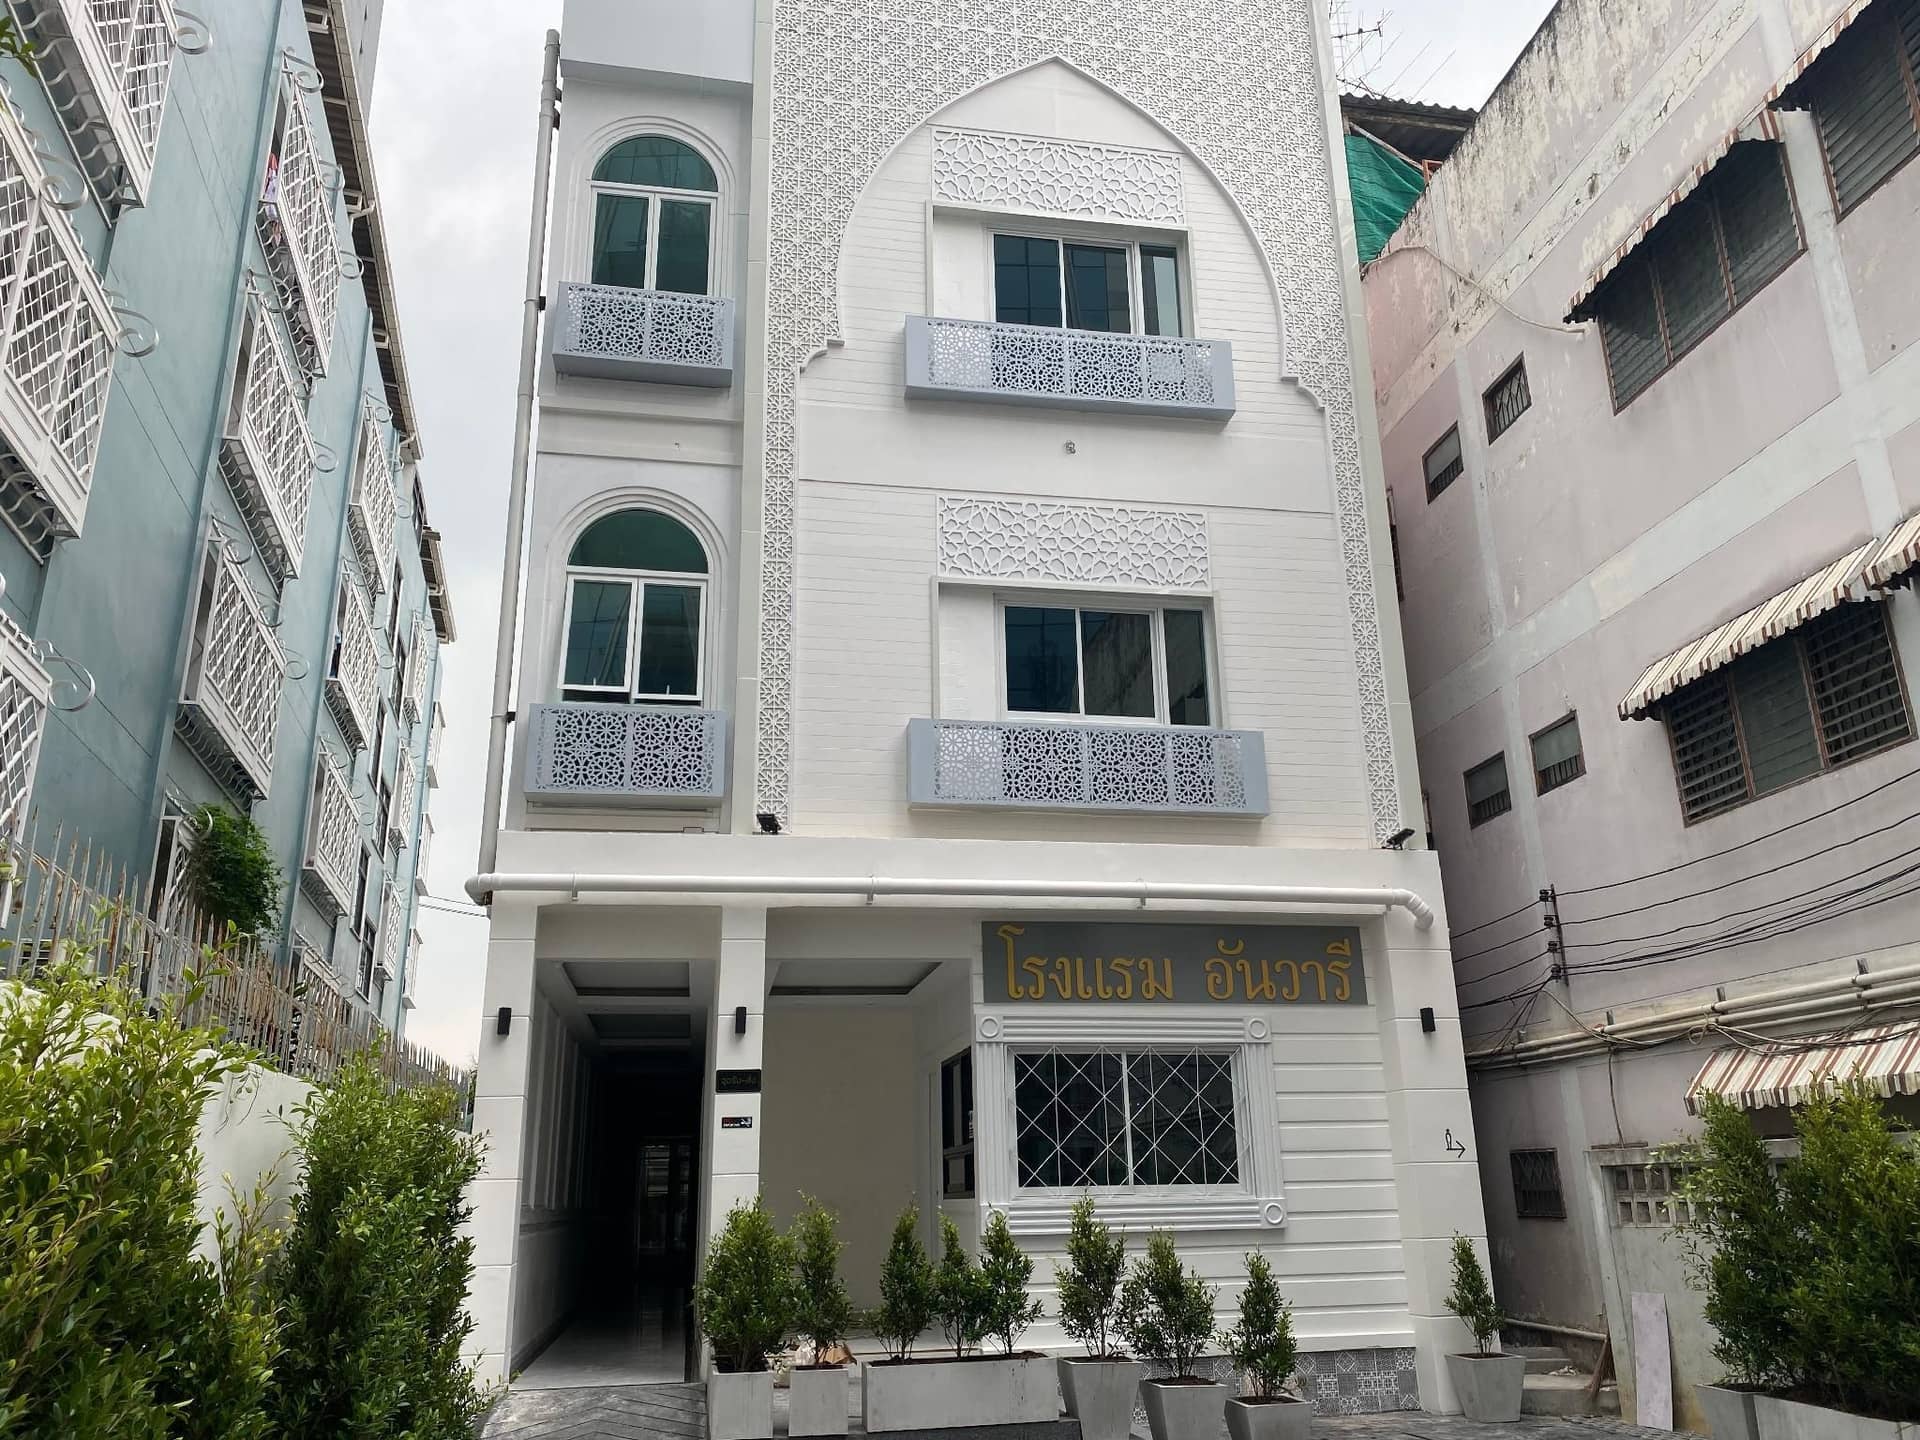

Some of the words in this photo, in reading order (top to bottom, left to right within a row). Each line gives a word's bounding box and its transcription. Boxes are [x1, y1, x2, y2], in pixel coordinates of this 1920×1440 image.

[997, 924, 1174, 1000] โรงแรม
[1204, 938, 1352, 1001] อันวารี
